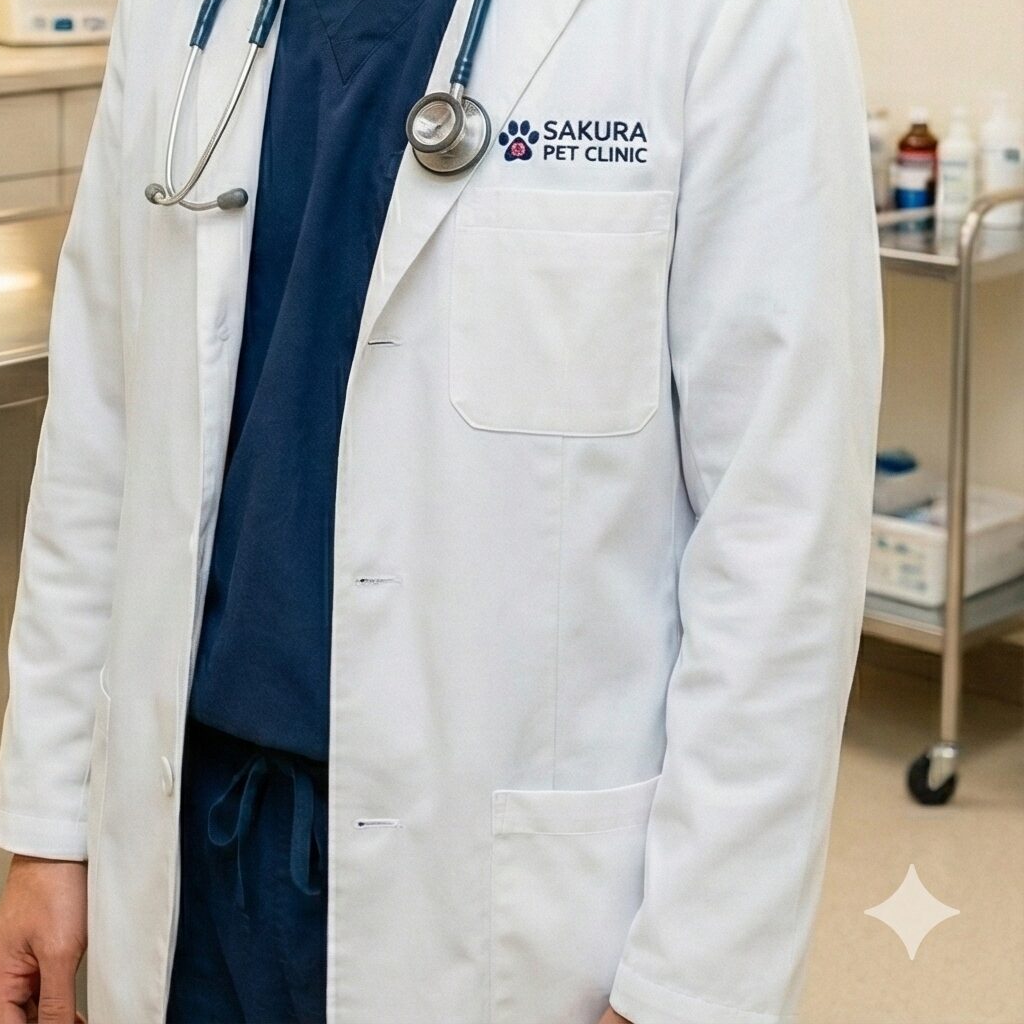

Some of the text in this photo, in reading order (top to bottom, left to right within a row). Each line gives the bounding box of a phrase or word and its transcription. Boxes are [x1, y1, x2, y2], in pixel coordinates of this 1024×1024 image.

[543, 120, 647, 142] SAKURA
[543, 145, 648, 163] PET CLINIC
